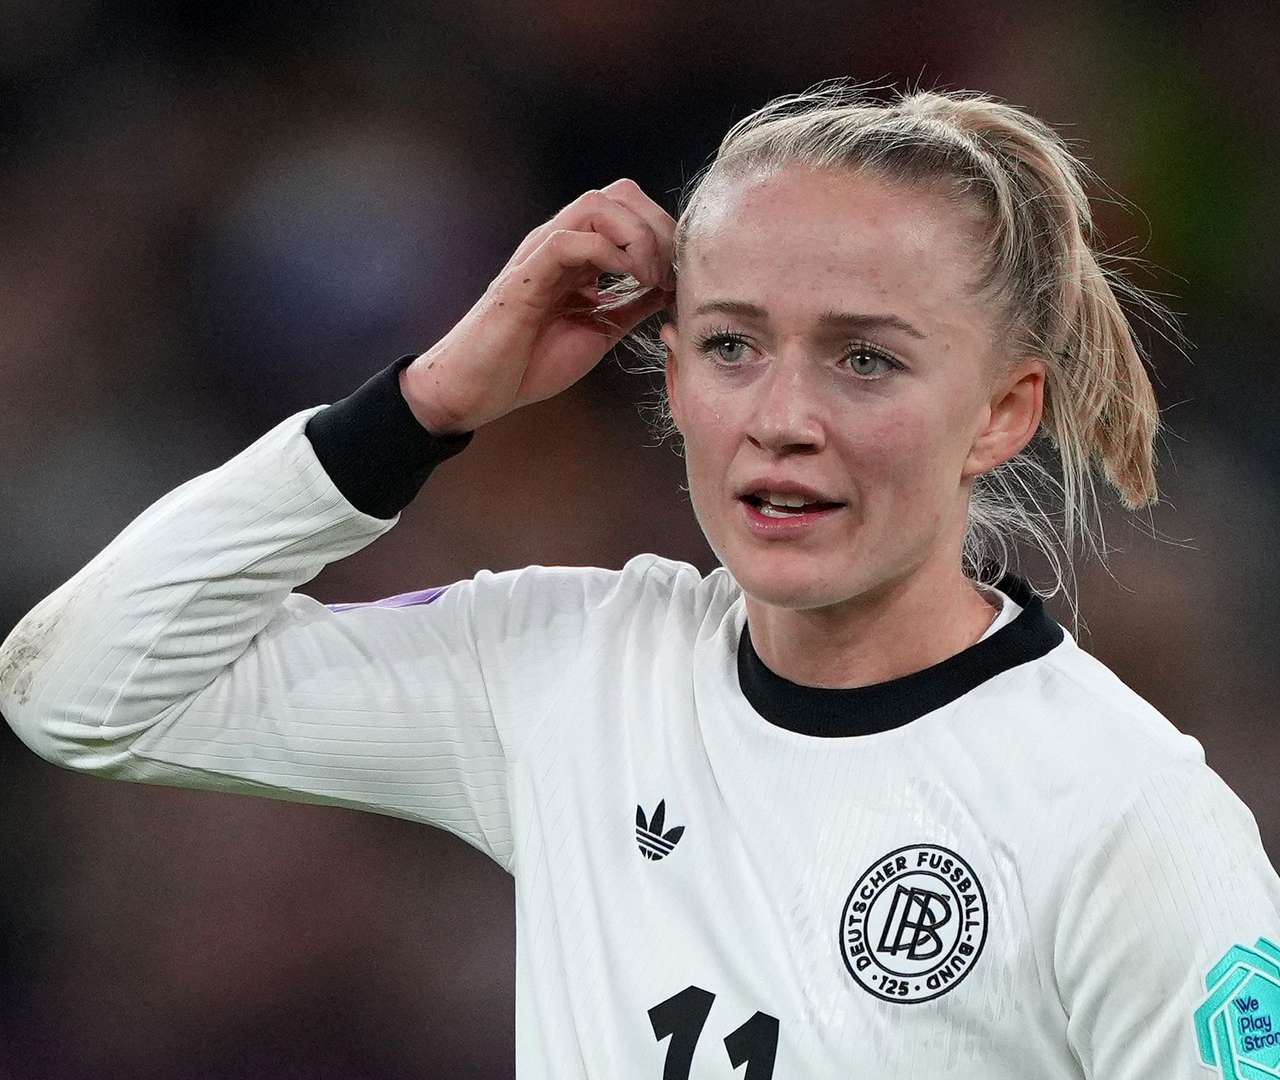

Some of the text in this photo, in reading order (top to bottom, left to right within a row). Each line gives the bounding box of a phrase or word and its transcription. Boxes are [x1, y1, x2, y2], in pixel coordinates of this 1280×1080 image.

[848, 856, 907, 972] DEUTSCHER
[879, 975, 910, 997] 125
[1234, 995, 1259, 1013] We
[1240, 1014, 1272, 1034] Play
